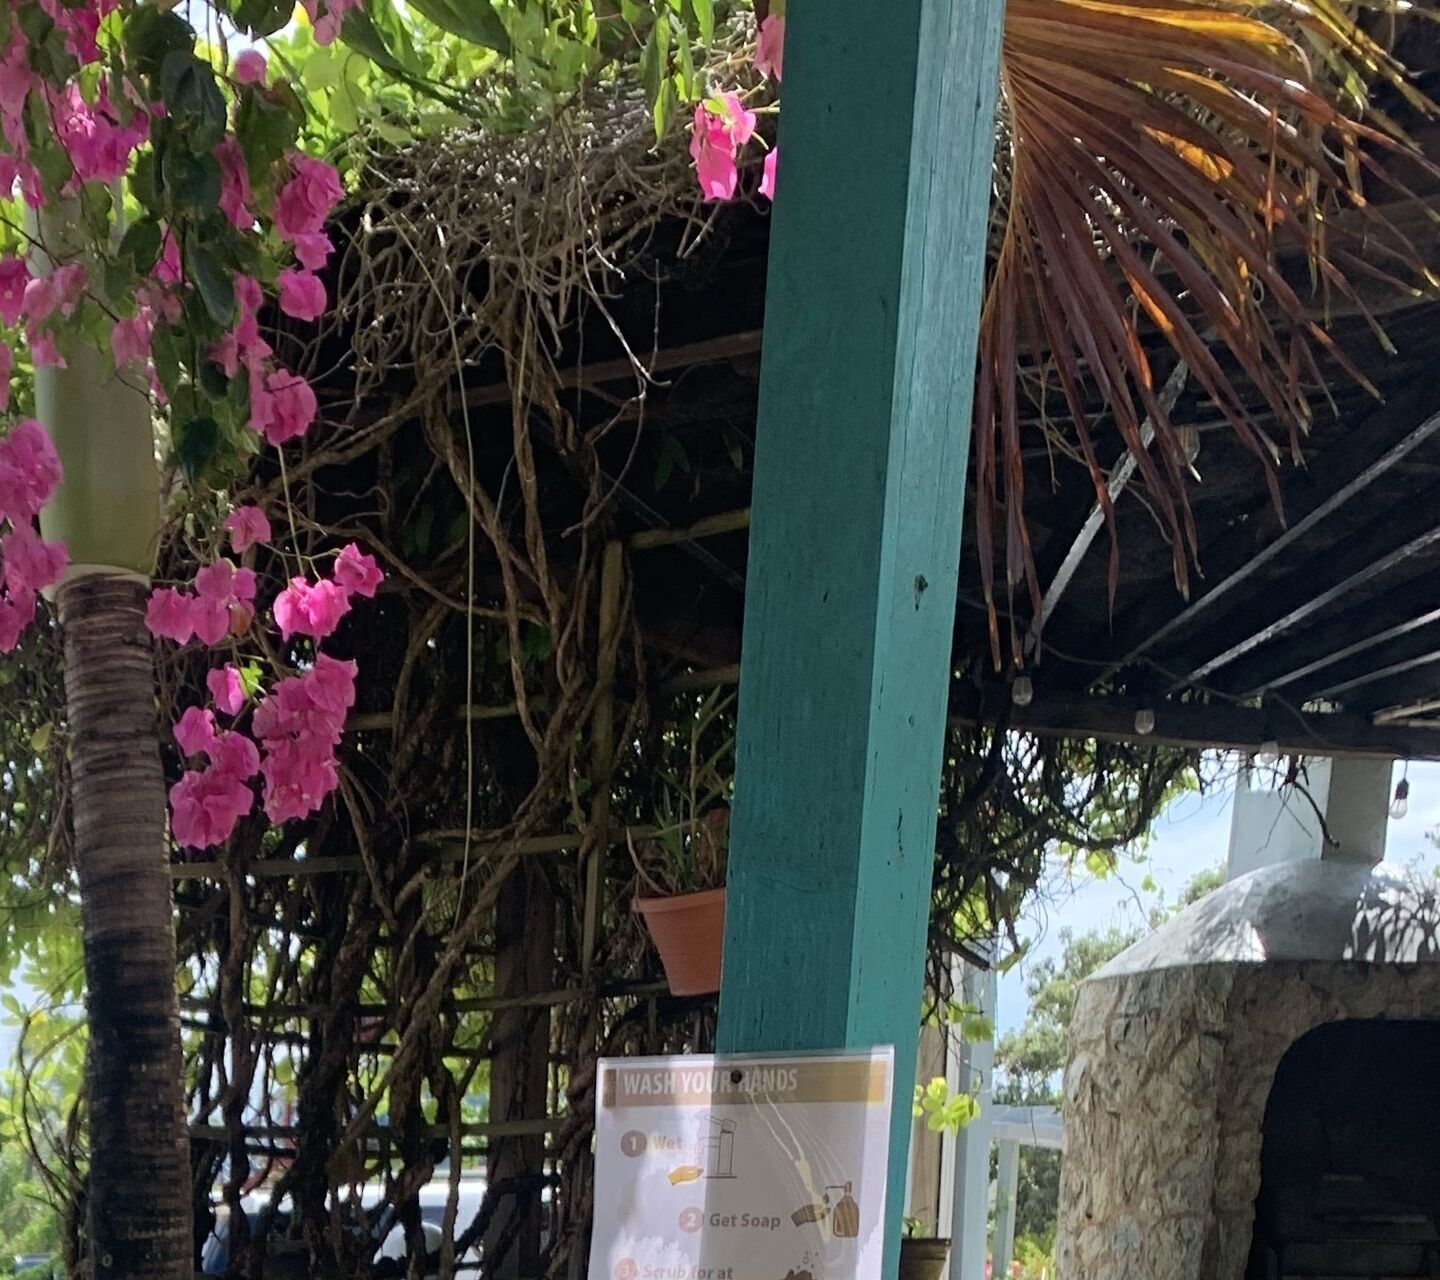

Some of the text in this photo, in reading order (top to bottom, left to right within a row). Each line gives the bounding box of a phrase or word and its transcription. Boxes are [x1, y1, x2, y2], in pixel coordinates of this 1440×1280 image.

[624, 1068, 798, 1096] WASH YOUR HANDS
[654, 1135, 682, 1150] Wet
[710, 1213, 736, 1228] Get
[742, 1213, 780, 1230] Soap
[691, 1265, 712, 1280] for
[717, 1266, 733, 1280] at
